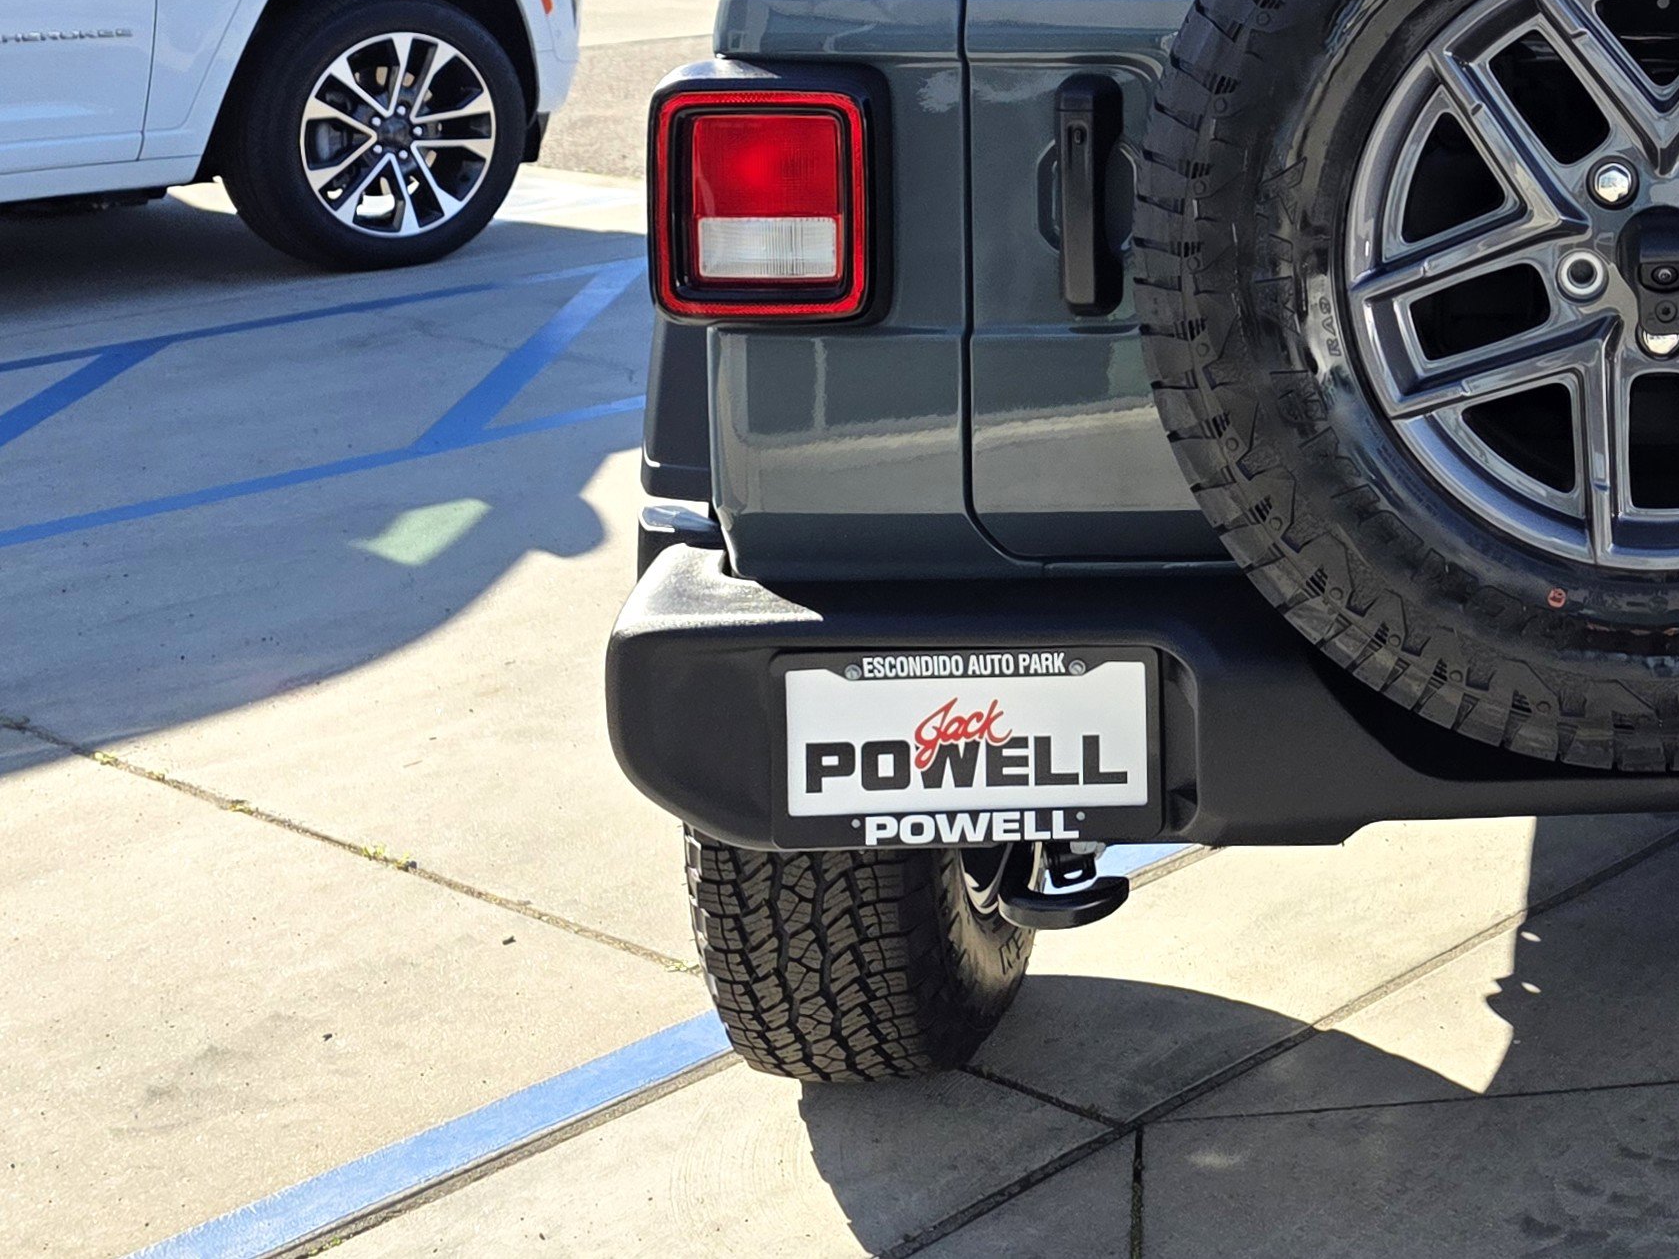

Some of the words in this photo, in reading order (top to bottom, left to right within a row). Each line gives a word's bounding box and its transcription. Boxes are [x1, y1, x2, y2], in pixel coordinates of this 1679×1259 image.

[862, 655, 964, 678] ESCONDIDO
[967, 654, 1014, 676] AUTO
[1018, 652, 1066, 674] PARK
[914, 696, 1012, 770] Jack
[805, 735, 1129, 793] POWELL
[865, 810, 1080, 845] POWELL
